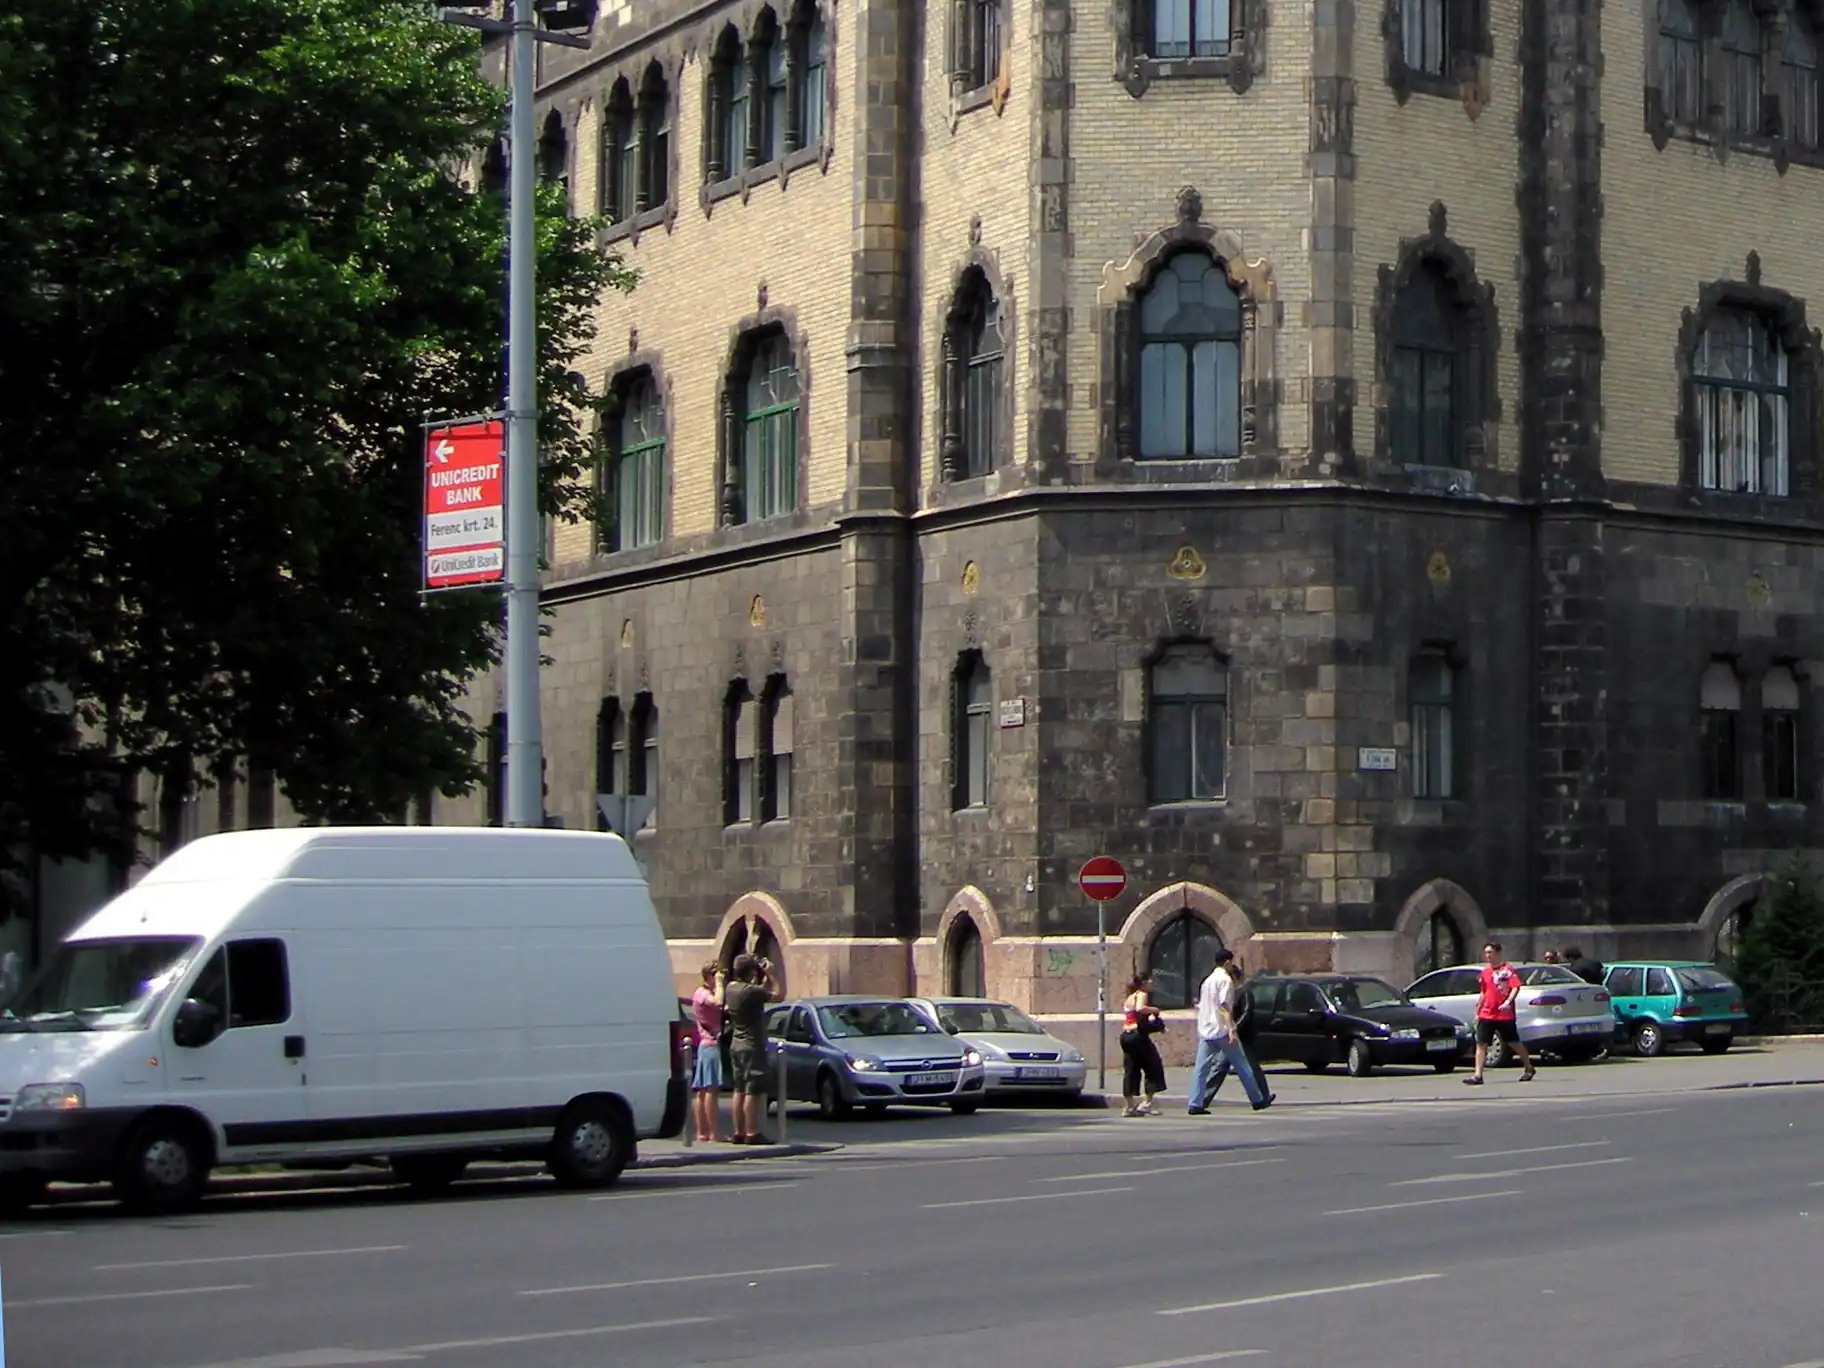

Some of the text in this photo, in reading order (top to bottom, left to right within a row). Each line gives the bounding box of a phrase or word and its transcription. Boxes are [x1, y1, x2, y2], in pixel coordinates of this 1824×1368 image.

[431, 464, 499, 487] UNICREDIT
[447, 486, 482, 505] BANK
[431, 523, 461, 537] Ferenc
[441, 553, 499, 573] UniCredit Bank
